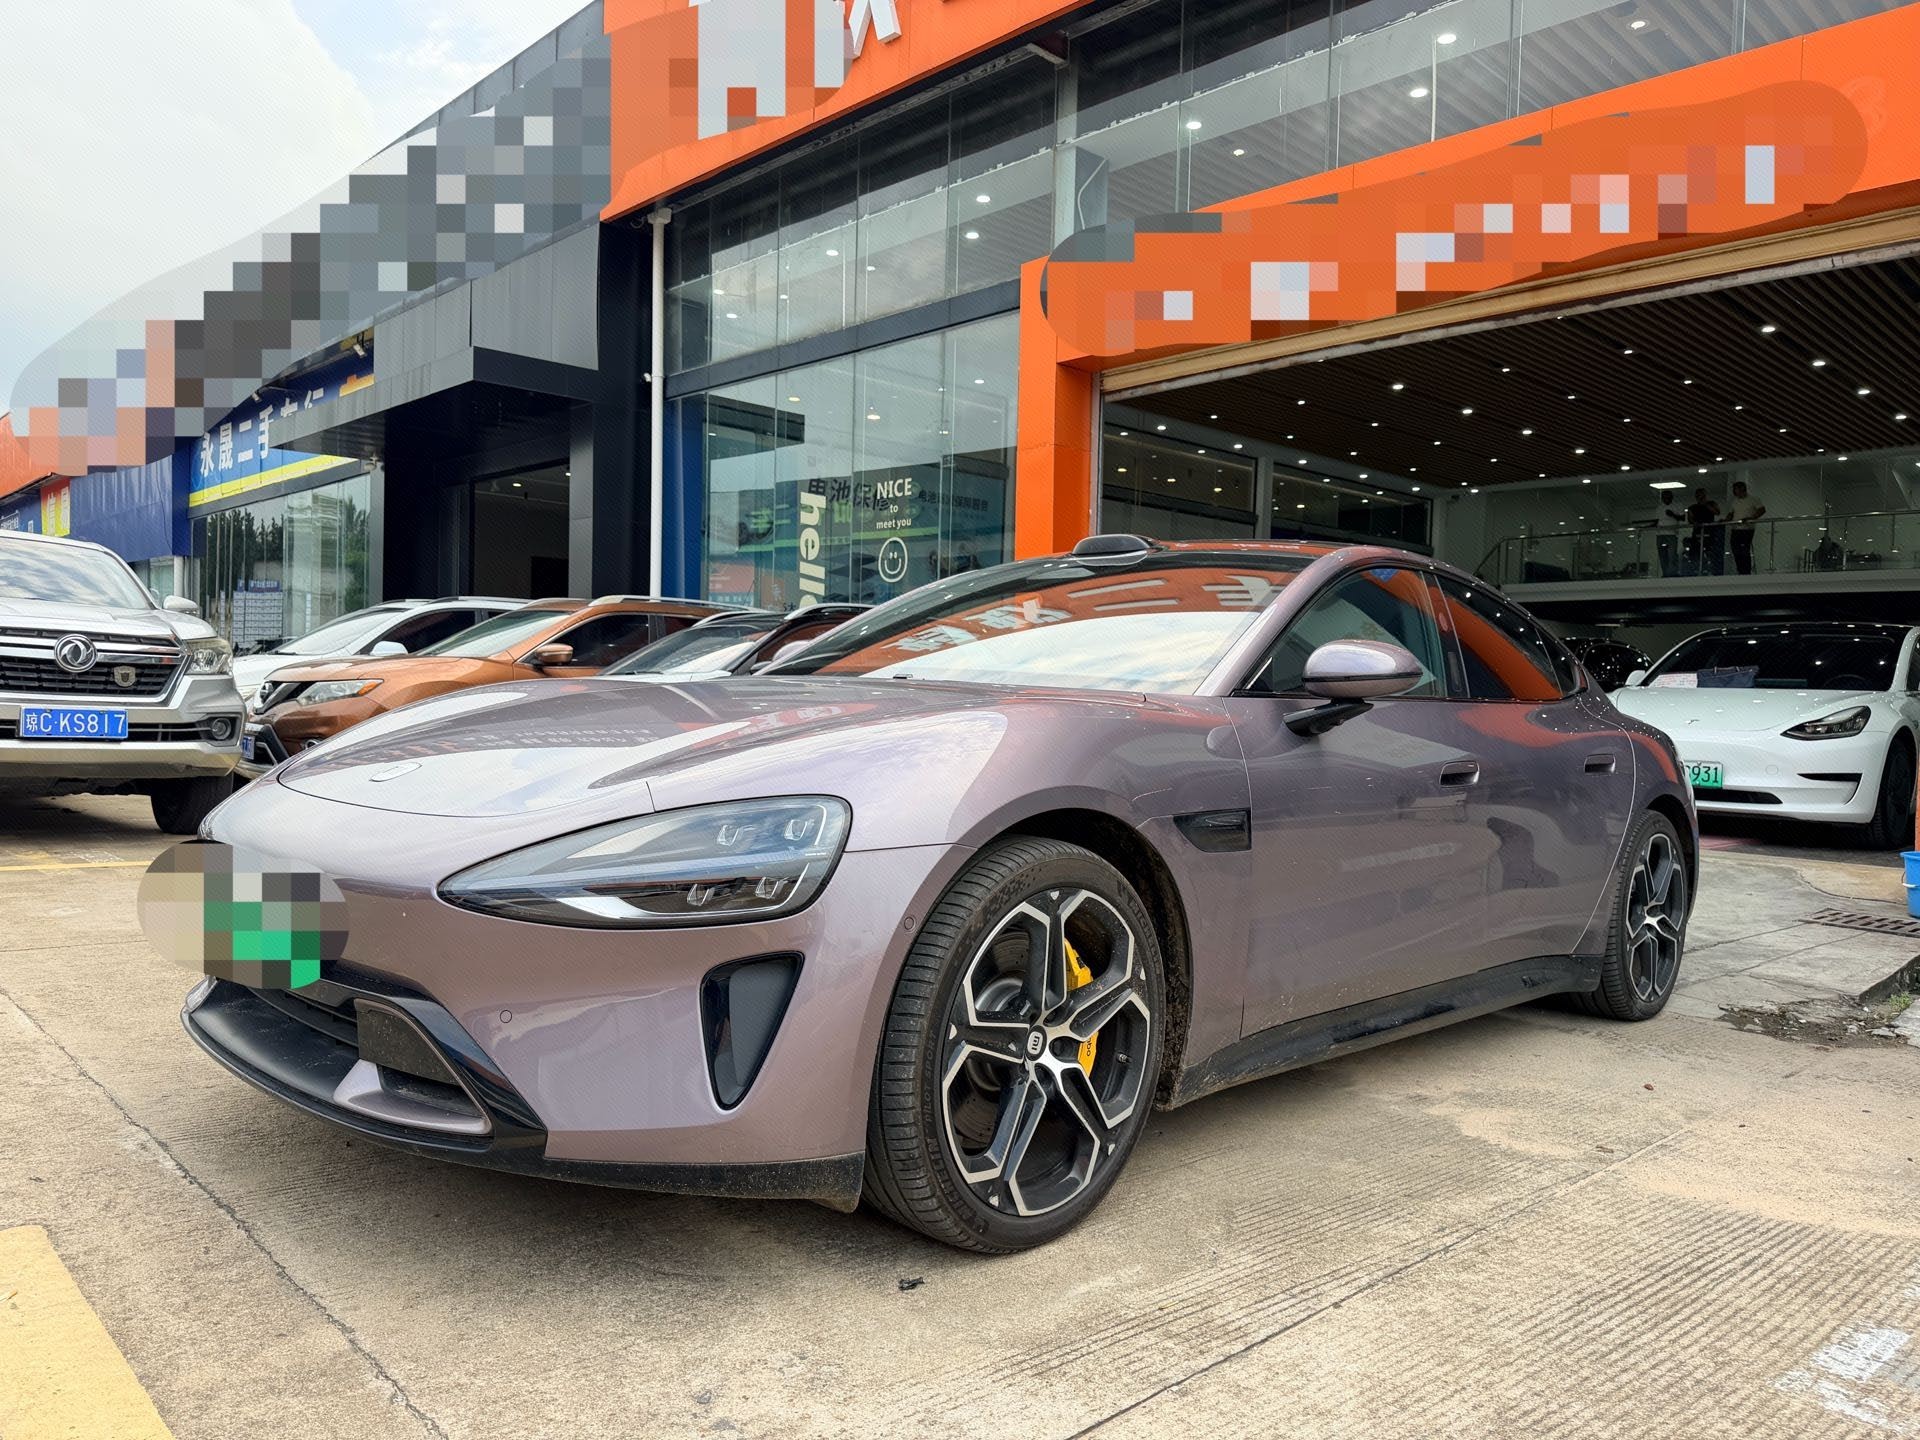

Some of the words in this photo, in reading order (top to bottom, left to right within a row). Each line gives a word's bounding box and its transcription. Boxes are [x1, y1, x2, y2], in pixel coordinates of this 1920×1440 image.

[877, 477, 912, 500] NICE
[890, 504, 899, 513] to
[876, 519, 896, 529] meet
[896, 518, 912, 530] you
